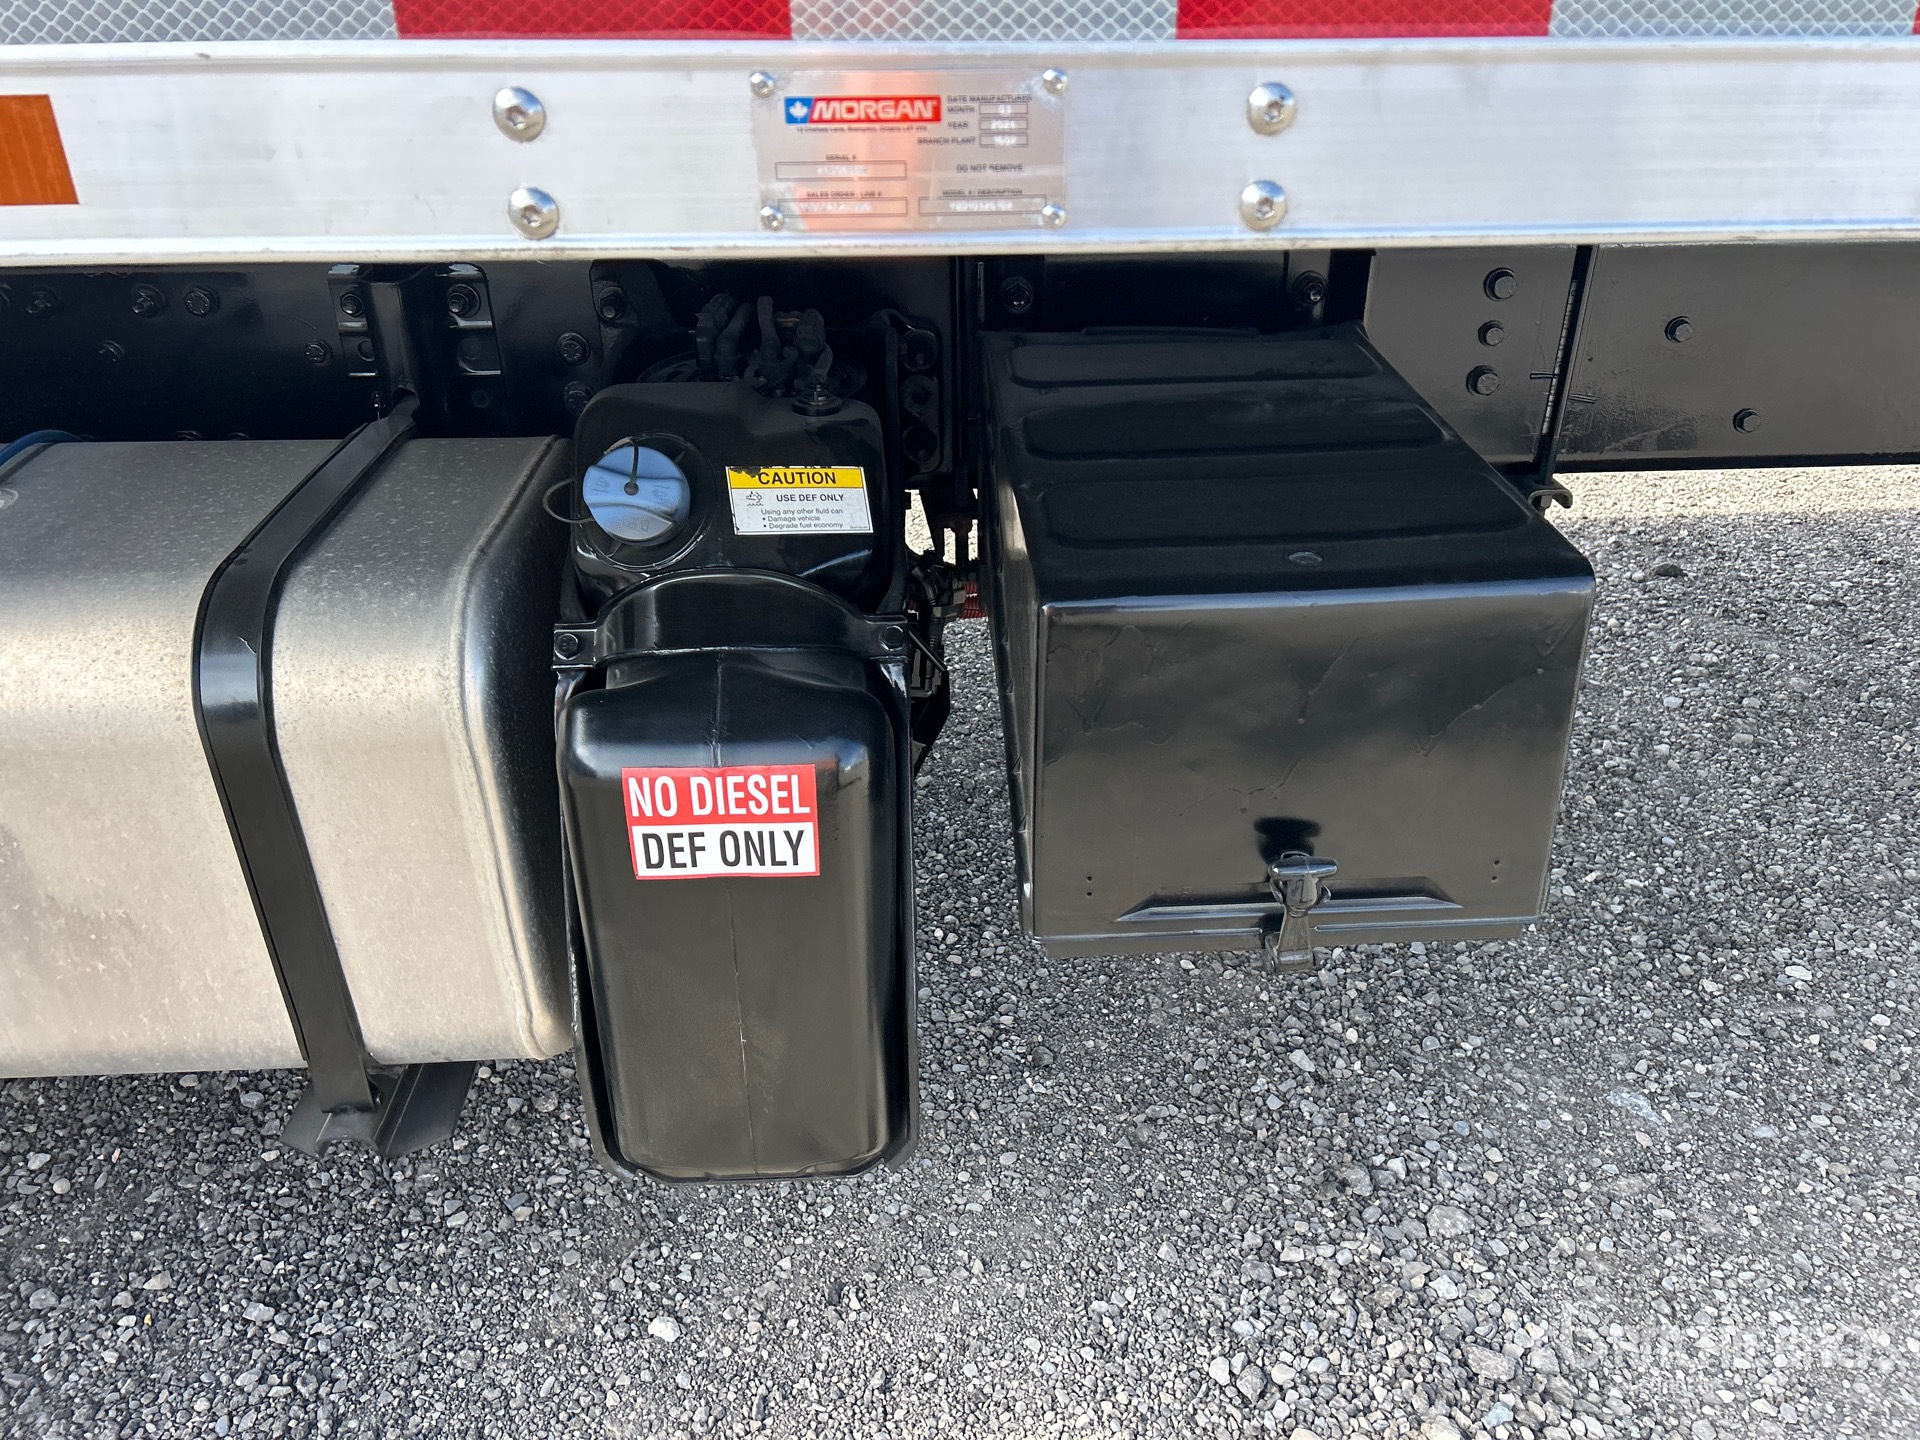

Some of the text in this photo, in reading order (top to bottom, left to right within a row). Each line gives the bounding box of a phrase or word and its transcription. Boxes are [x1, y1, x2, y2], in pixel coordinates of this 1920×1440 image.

[812, 99, 934, 120] MORGAN
[970, 164, 988, 172] NOT
[758, 472, 837, 485] CAUTION
[776, 493, 844, 502] USE DEF ONLY
[769, 523, 798, 531] Degrade
[628, 774, 811, 817] NO DIESEL
[642, 830, 805, 869] DEF ONLY
